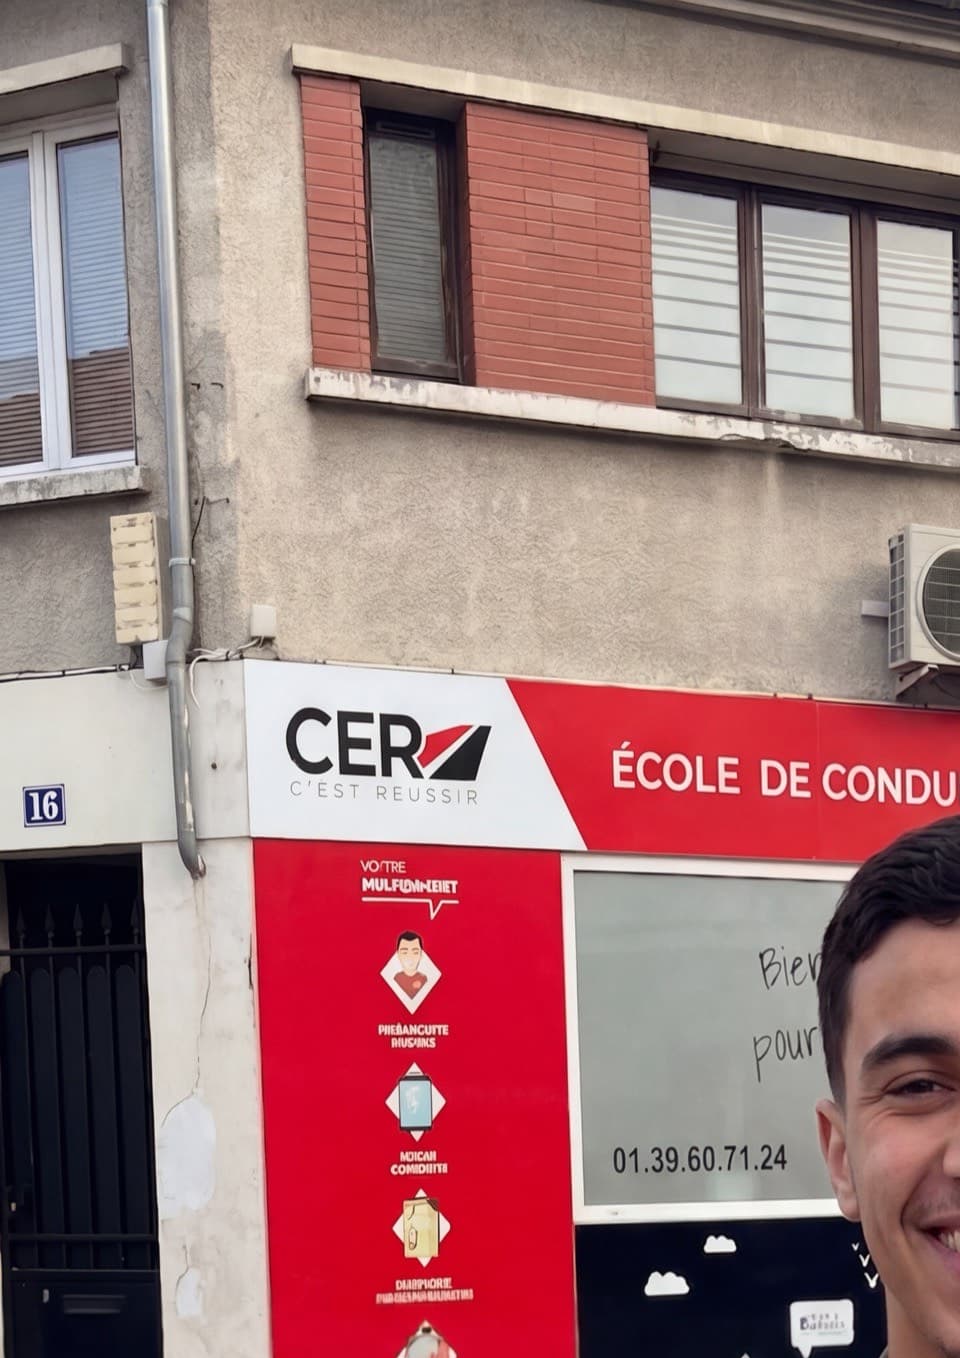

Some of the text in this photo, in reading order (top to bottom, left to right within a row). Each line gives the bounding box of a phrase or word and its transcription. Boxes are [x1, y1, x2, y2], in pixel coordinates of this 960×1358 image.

[285, 707, 424, 778] CER
[612, 741, 741, 794] ÉCOLE
[760, 758, 811, 799] DE
[29, 789, 58, 821] 16
[289, 781, 479, 805] C'EST REUSSIR
[753, 1027, 818, 1082] pour
[613, 1144, 787, 1173] 01.39.60.71.24
